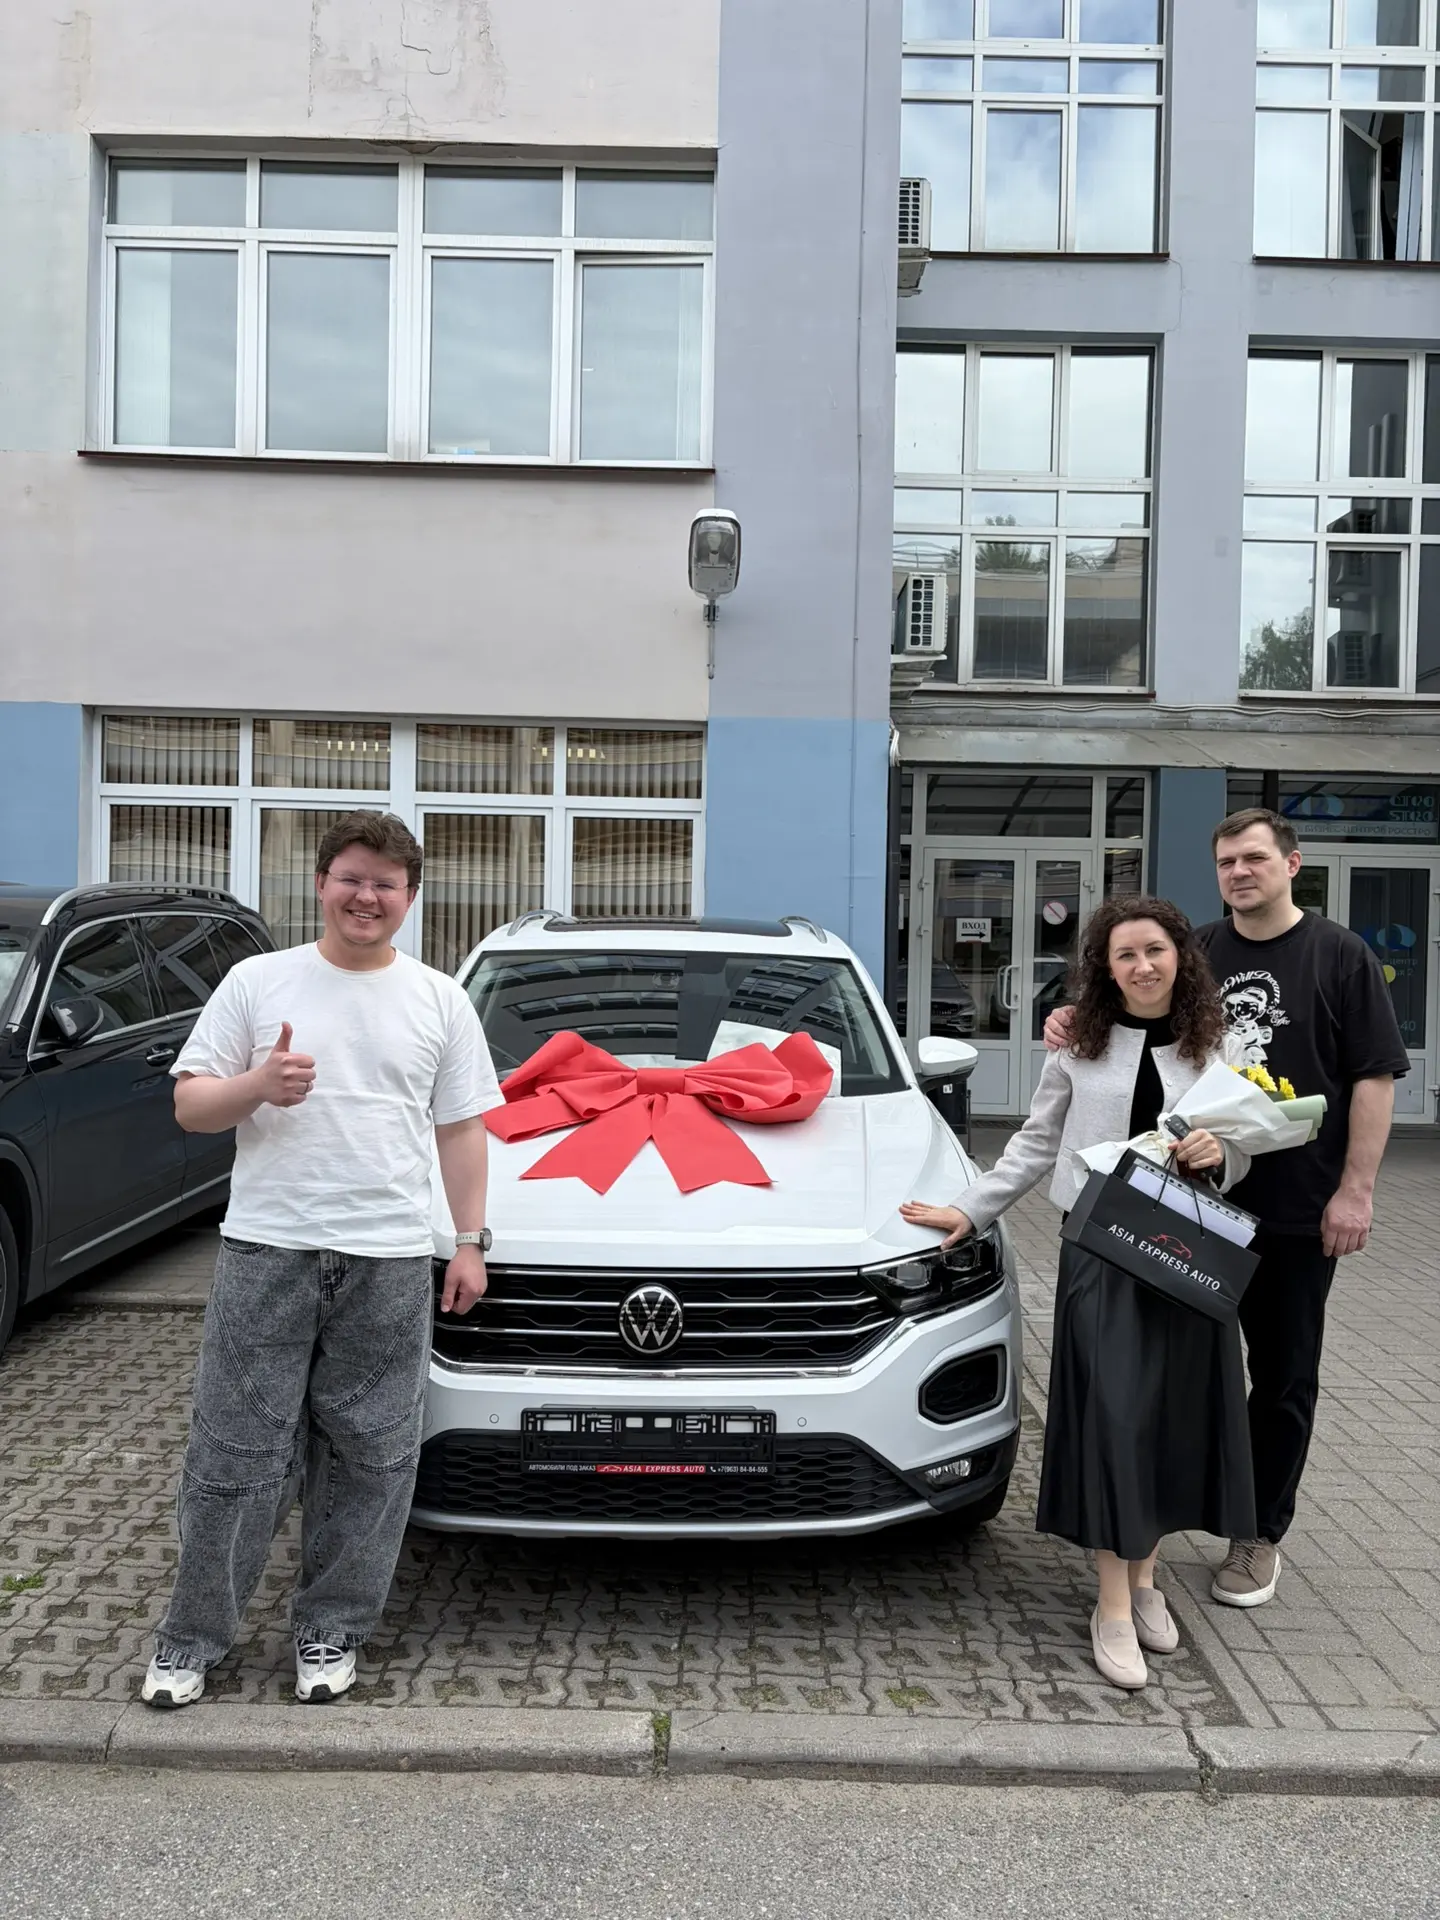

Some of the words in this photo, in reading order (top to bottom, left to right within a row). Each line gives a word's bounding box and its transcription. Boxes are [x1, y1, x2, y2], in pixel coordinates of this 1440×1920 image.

[961, 921, 987, 930] ВХОД
[1108, 1224, 1135, 1245] ASIA
[1138, 1240, 1190, 1274] EXPRESS
[1190, 1269, 1221, 1291] AUTO
[566, 1464, 579, 1472] ПОД
[623, 1465, 642, 1473] ASIA
[645, 1465, 681, 1473] EXPRESS
[683, 1465, 705, 1473] AUTO
